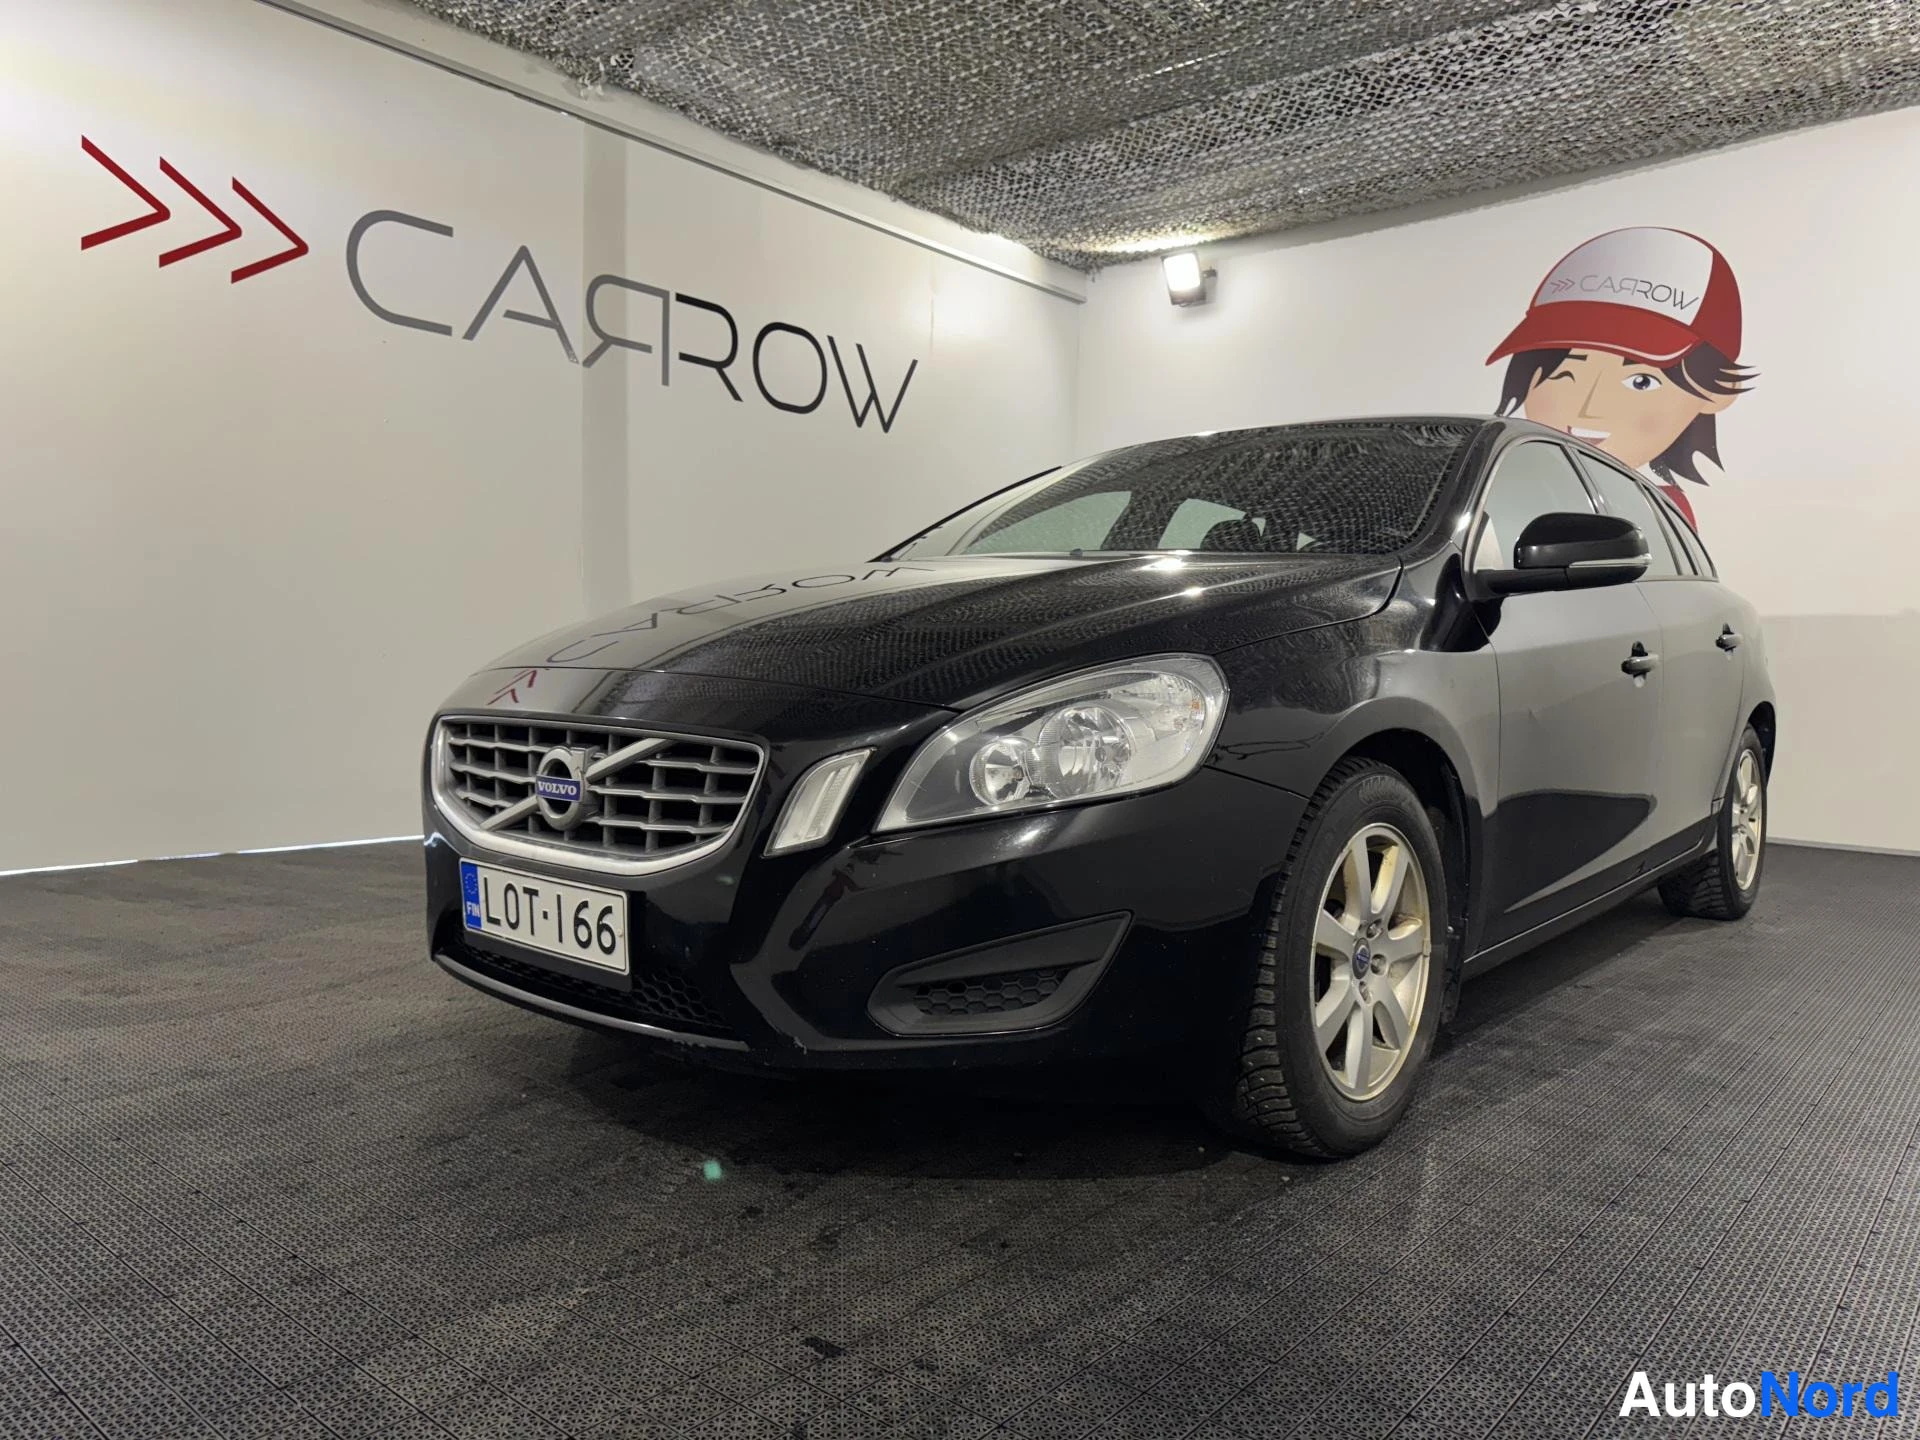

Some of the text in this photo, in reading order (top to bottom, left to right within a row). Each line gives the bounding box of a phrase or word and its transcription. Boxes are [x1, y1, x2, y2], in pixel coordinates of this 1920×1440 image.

[1579, 274, 1700, 310] CARROW
[346, 210, 918, 433] CARROW
[537, 780, 578, 796] VOLVO
[466, 901, 481, 919] FIN
